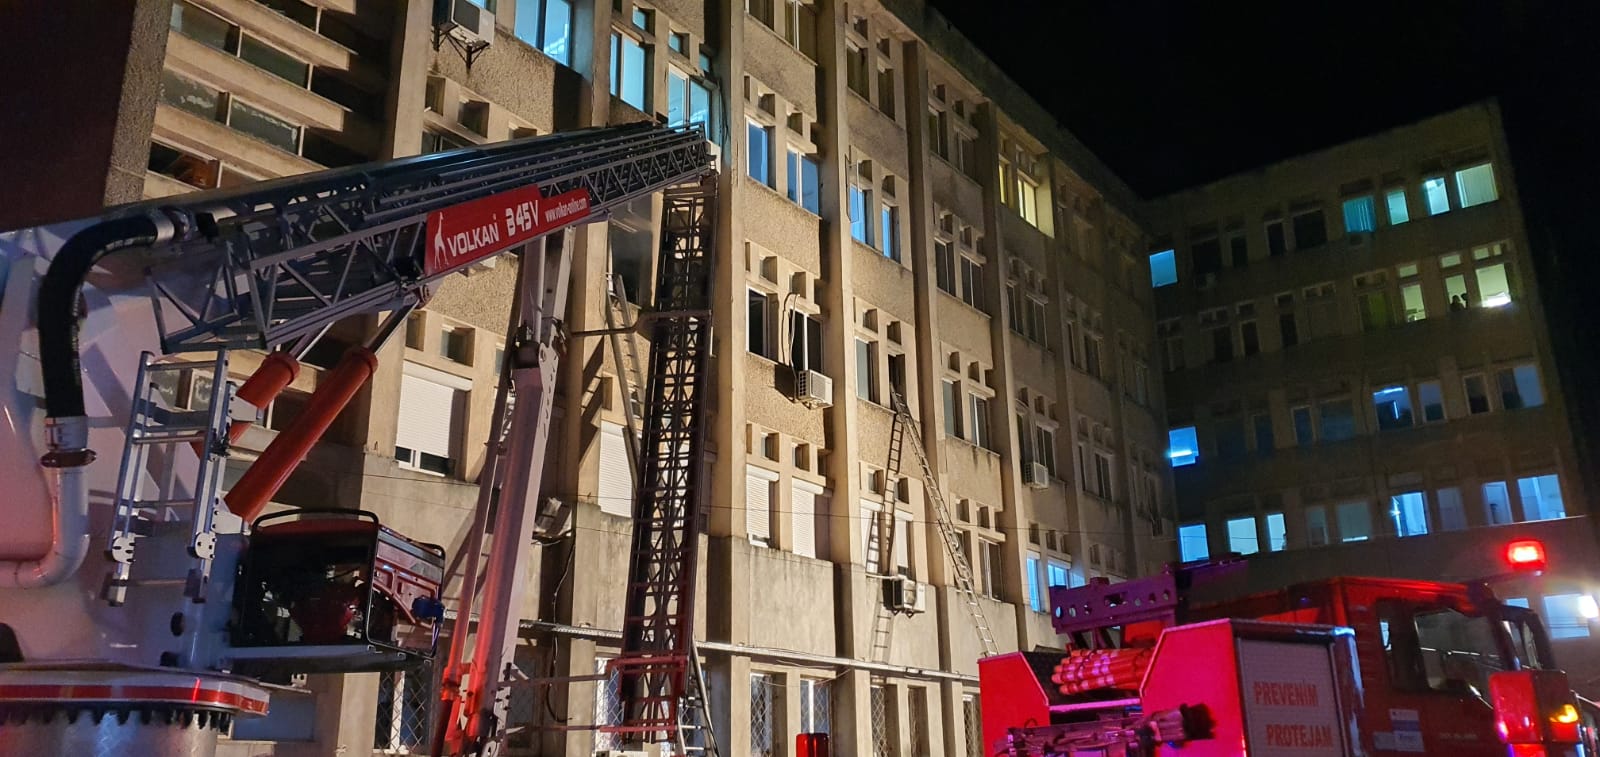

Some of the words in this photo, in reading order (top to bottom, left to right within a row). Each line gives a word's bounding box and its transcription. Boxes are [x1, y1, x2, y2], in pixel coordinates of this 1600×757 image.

[447, 217, 500, 257] VOLKAN
[1253, 681, 1318, 707] PREVENIM
[1265, 723, 1334, 749] PROTEJAM
